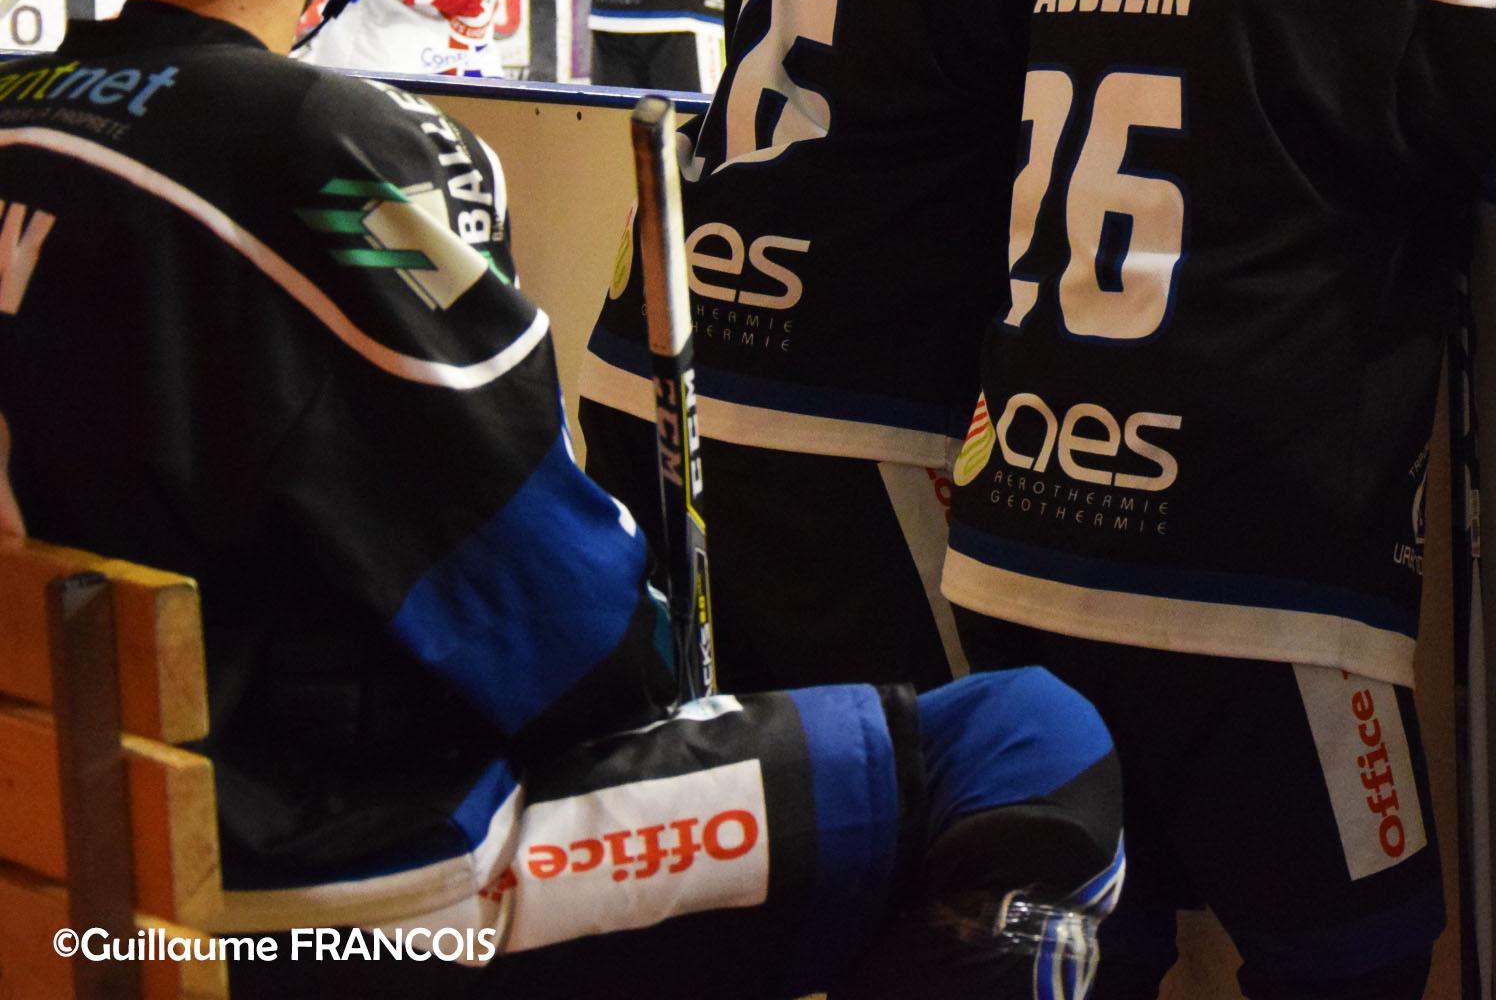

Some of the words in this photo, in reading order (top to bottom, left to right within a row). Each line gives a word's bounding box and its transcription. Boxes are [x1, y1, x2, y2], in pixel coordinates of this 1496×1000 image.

[1008, 69, 1185, 340] 26
[997, 392, 1183, 492] aes
[1351, 688, 1406, 859] Office
[527, 808, 759, 883] Office
